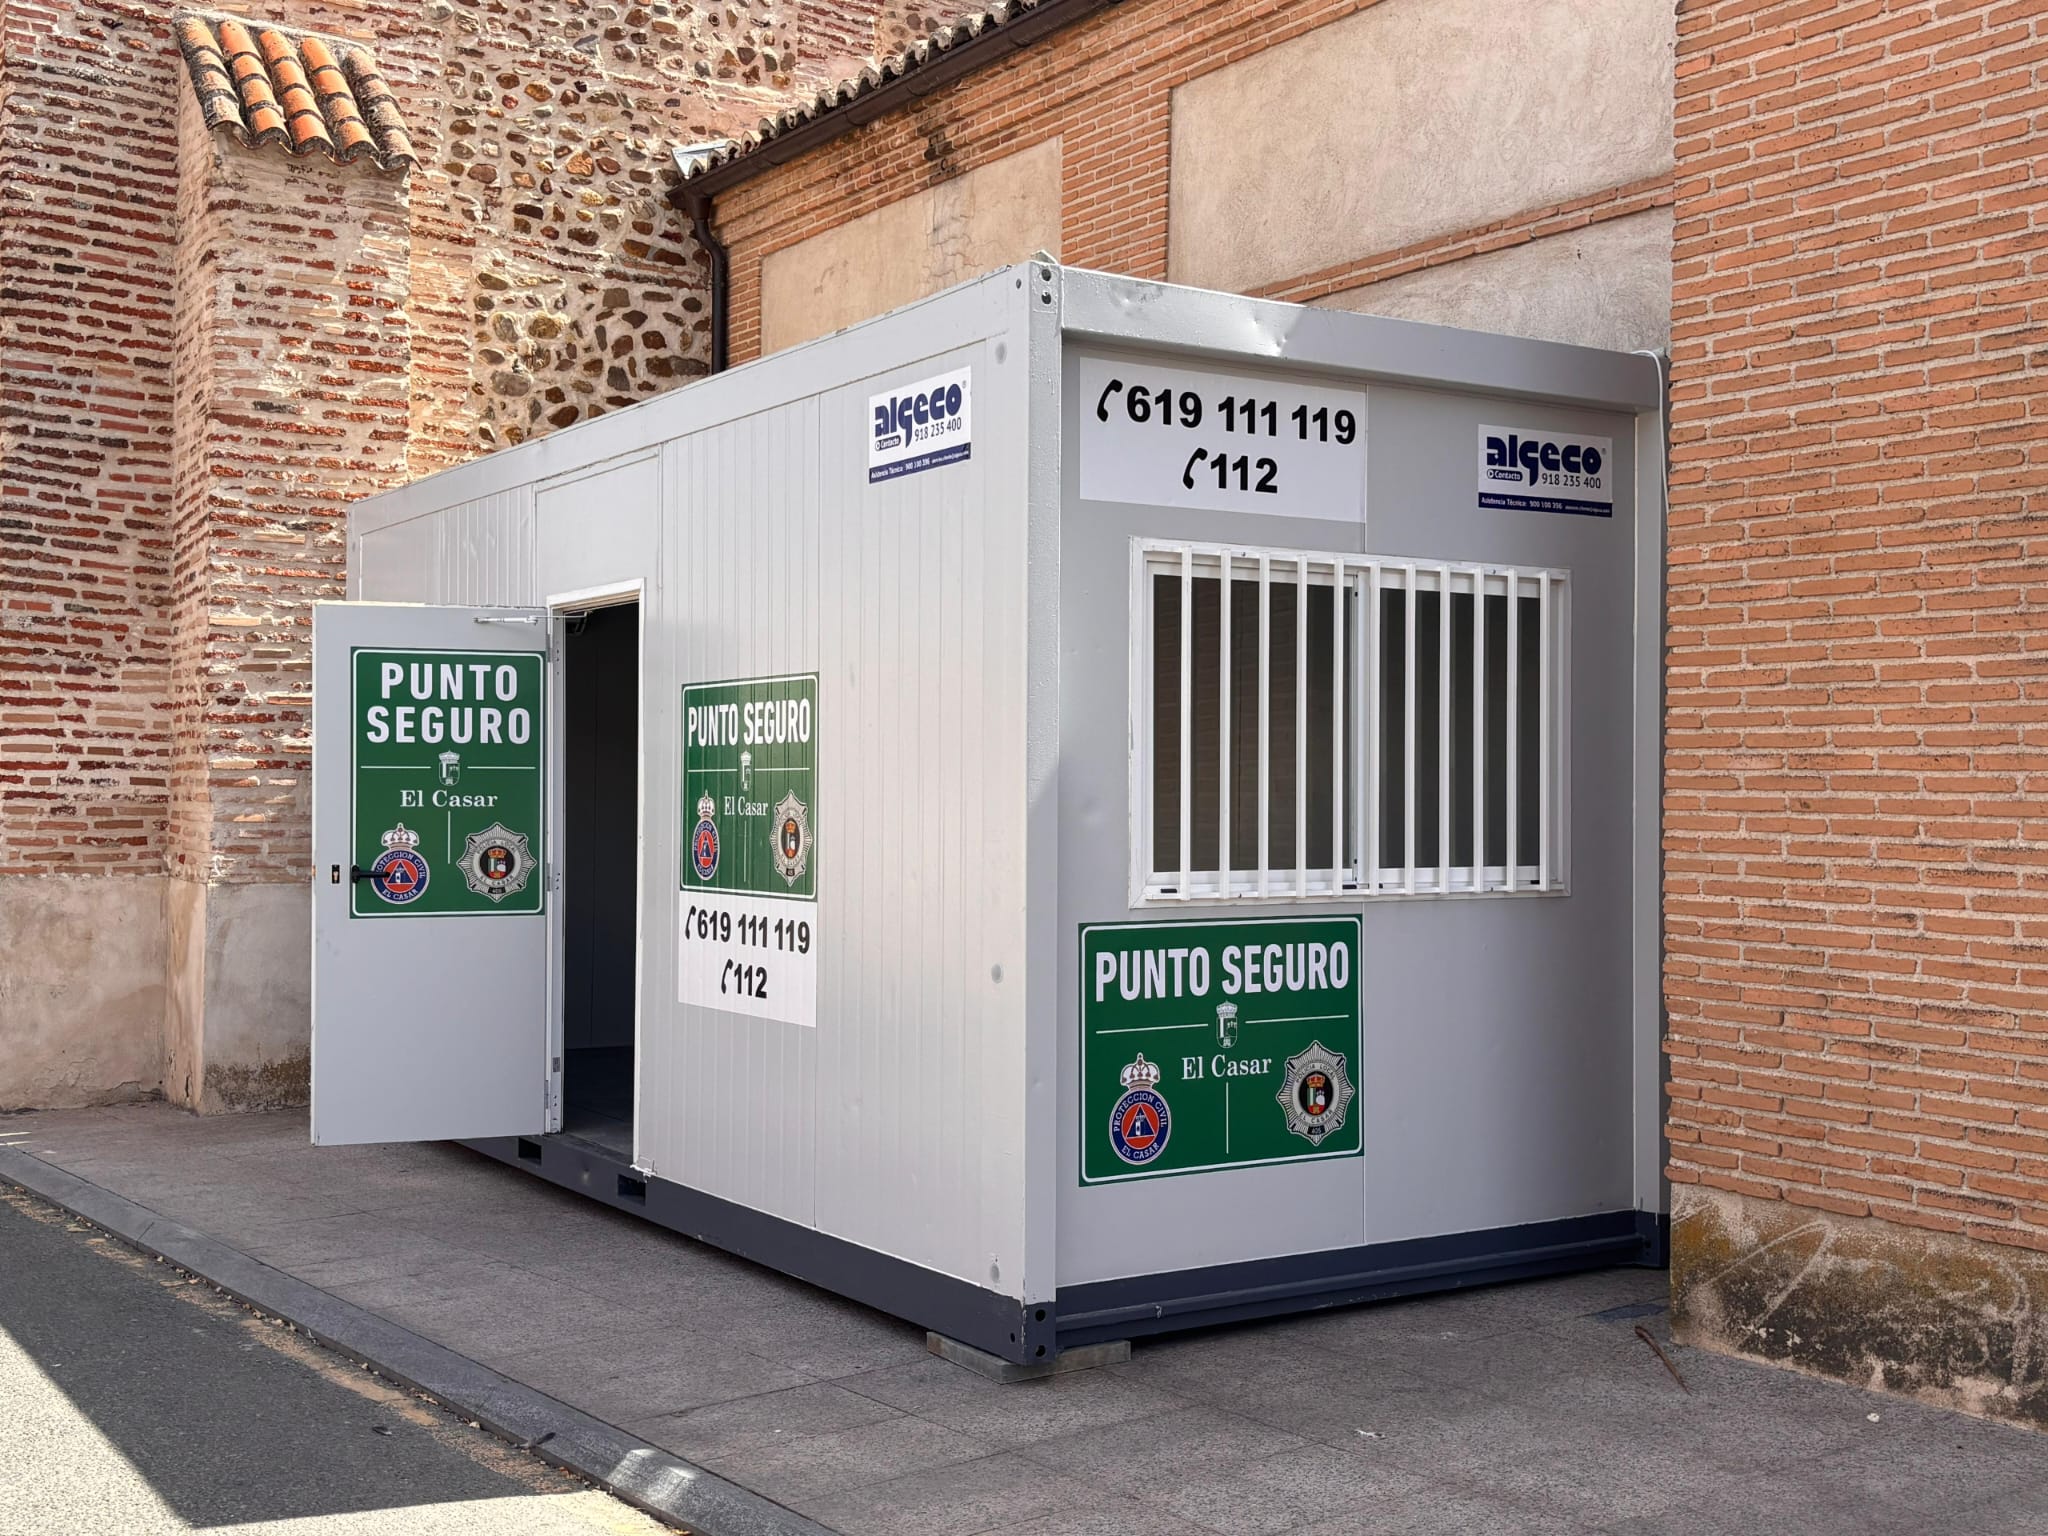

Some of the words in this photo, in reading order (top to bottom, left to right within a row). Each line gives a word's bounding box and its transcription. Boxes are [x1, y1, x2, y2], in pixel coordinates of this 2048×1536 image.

[914, 426, 929, 442] 918
[931, 422, 944, 438] 235
[946, 417, 962, 432] 400
[1126, 385, 1203, 428] 619
[1217, 396, 1277, 437] 111
[1291, 405, 1356, 445] 119
[1210, 453, 1278, 493] 112
[1494, 470, 1521, 481] Contacto
[1541, 473, 1560, 486] 918
[1563, 475, 1581, 487] 235
[1583, 477, 1601, 489] 400
[381, 662, 517, 702] PUNTO
[366, 705, 530, 744] SEGURO
[688, 703, 738, 747] PUNTO
[743, 698, 811, 746] SEGURO
[400, 789, 424, 807] El
[432, 790, 498, 808] Casar
[724, 796, 735, 815] El
[738, 796, 769, 816] Casar
[393, 888, 418, 901] CASAR
[697, 909, 731, 943] 619
[737, 913, 768, 948] 111
[774, 918, 811, 954] 119
[734, 963, 768, 999] 112
[1095, 946, 1210, 1003] PUNTO
[1221, 941, 1349, 995] SEGURO
[1181, 1056, 1203, 1080] El
[1211, 1054, 1273, 1078] Casar
[1113, 1092, 1155, 1132] PROTECCION
[1155, 1101, 1168, 1128] CIVIL
[1121, 1145, 1131, 1157] EL
[1133, 1142, 1160, 1160] CASAR
